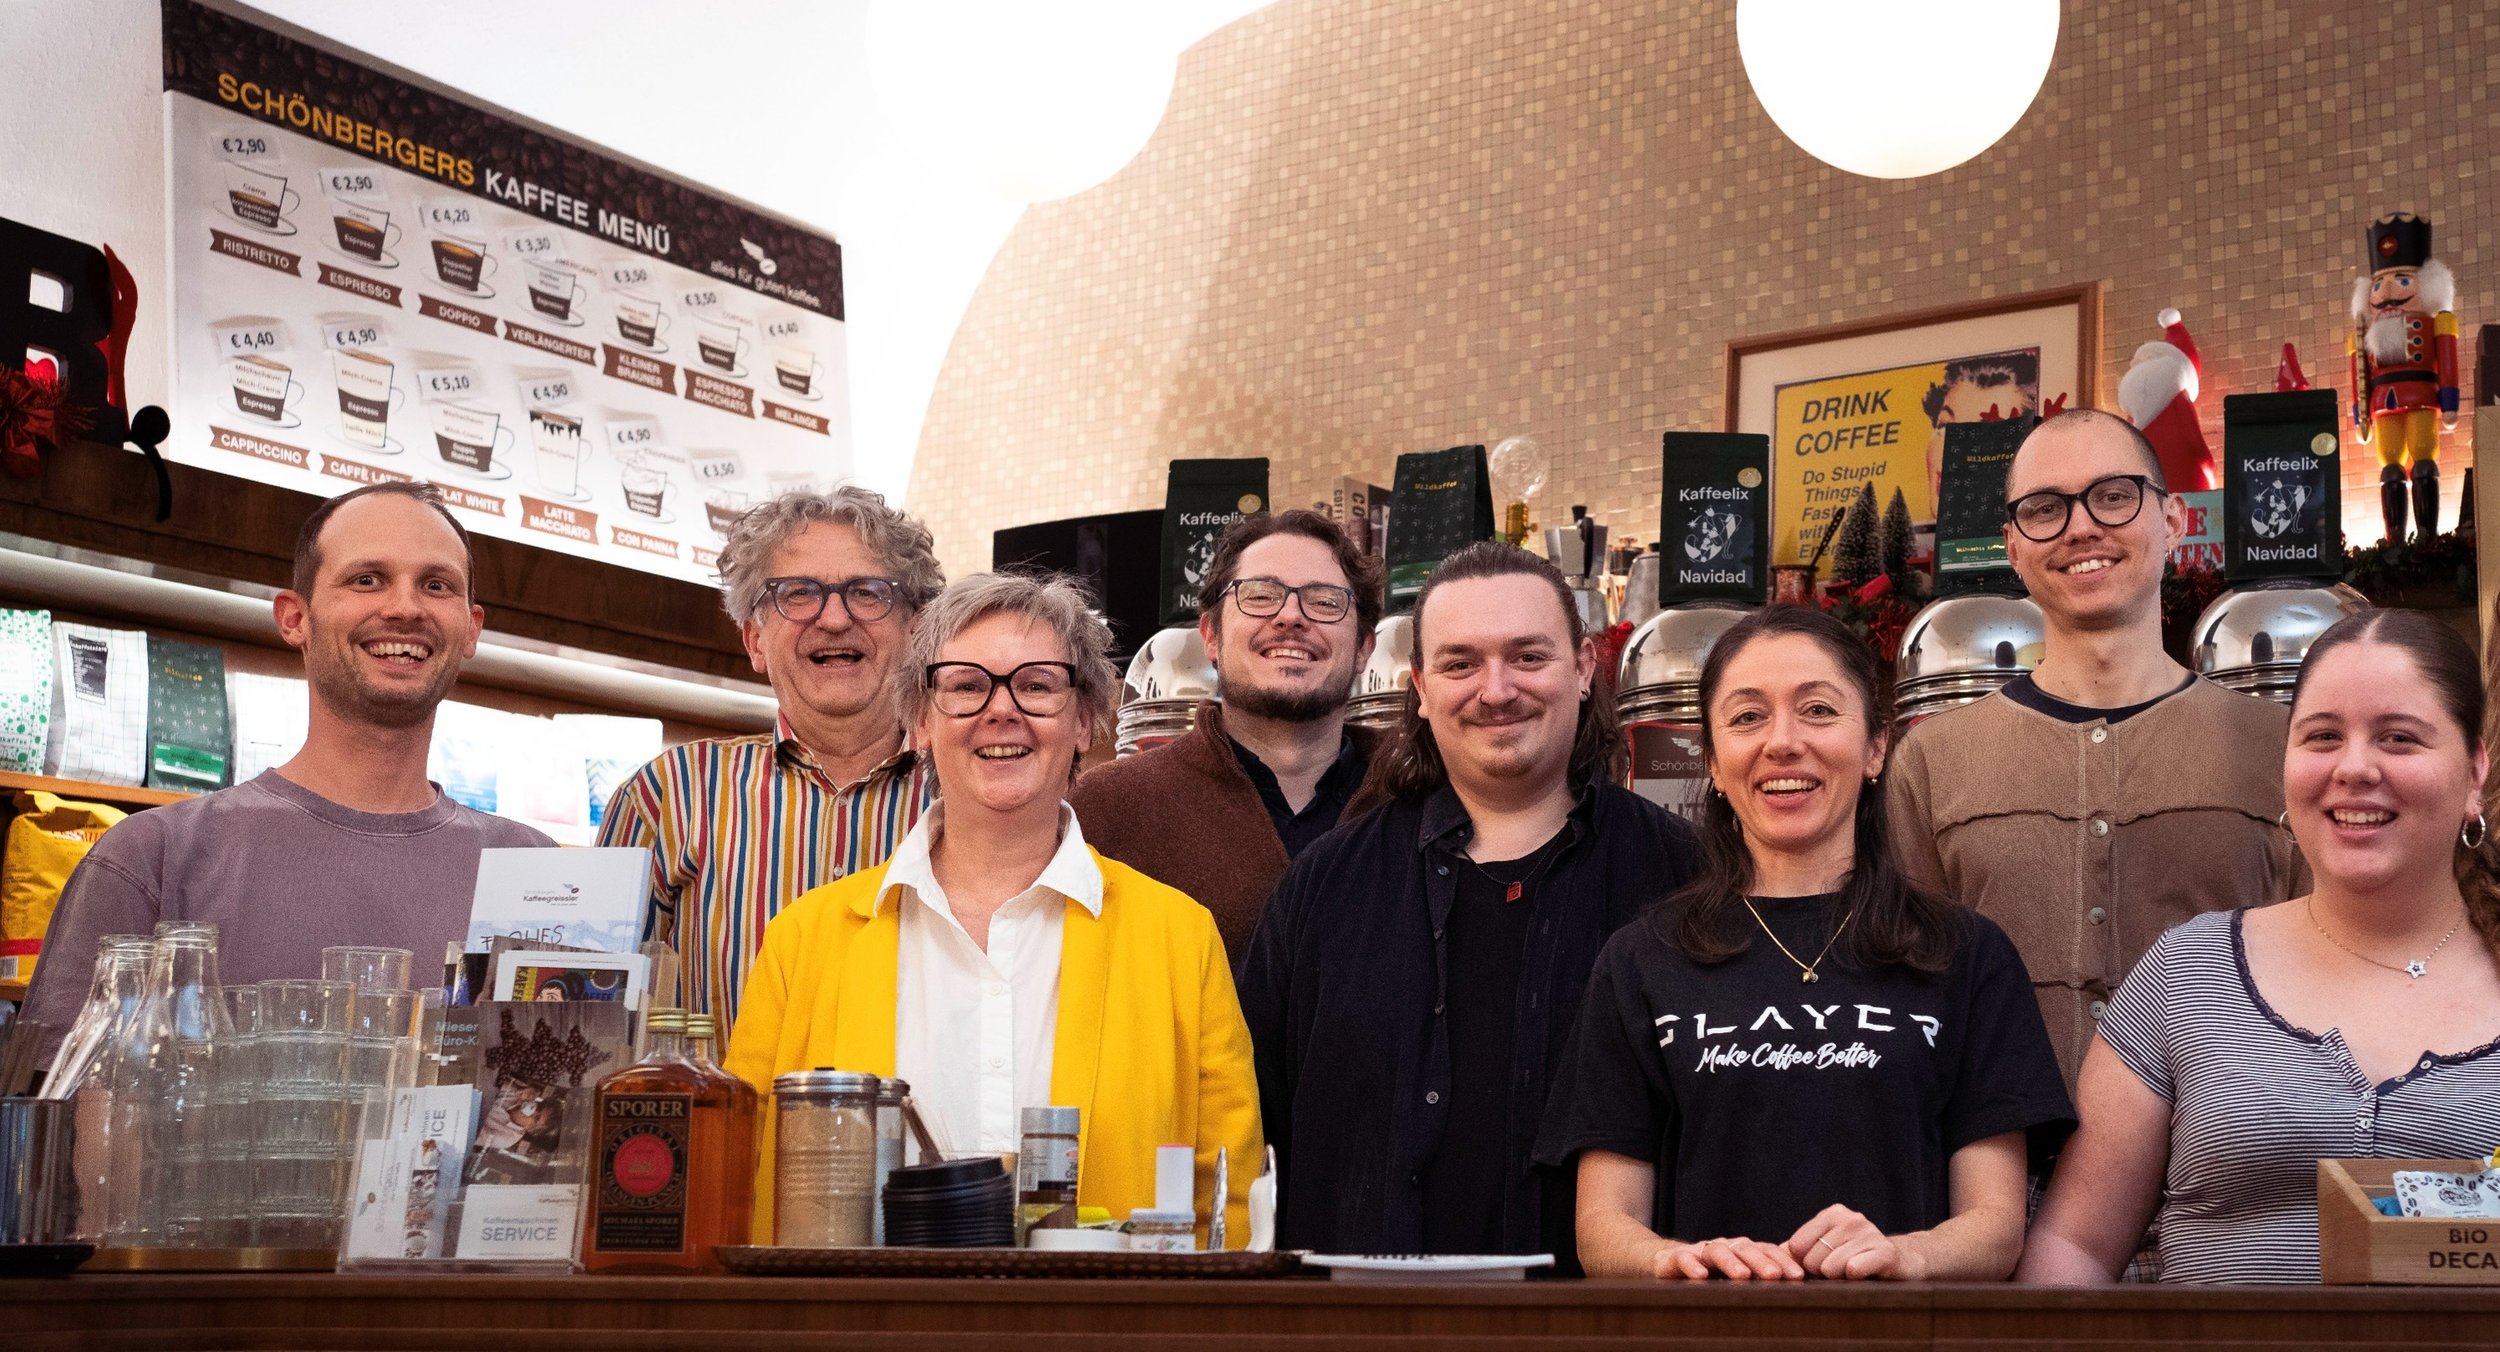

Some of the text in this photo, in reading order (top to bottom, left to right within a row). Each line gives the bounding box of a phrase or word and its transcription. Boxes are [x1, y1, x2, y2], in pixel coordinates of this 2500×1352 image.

[235, 138, 266, 155] 2,90
[217, 72, 670, 254] SCHÖNBERGERS KAFFEE MENÜ
[345, 176, 373, 192] 2,90
[238, 207, 273, 225] Espresso
[444, 209, 470, 224] 4,20
[344, 233, 376, 250] Espresso
[527, 237, 550, 254] 3,30
[223, 239, 290, 269] RISTRETTO
[624, 269, 647, 283] 3,50
[329, 271, 392, 300] ESPRESSO
[695, 292, 717, 306] 3,50
[439, 305, 480, 328] DOPPIO
[244, 331, 274, 351] 4,40
[348, 328, 377, 346] 4,90
[511, 327, 592, 360] VERLÄNGERTER
[619, 353, 661, 374] KLEINER
[443, 376, 470, 392] 5,10
[544, 383, 568, 399] 4,90
[695, 376, 745, 399] ESPRESSO
[242, 396, 276, 413] Espresso
[347, 401, 379, 417] Espresso
[693, 388, 748, 414] MACCHIATO
[1802, 389, 1893, 424] DRINK
[775, 407, 818, 429] MELANGE
[627, 428, 651, 443] 4,90
[1795, 421, 1901, 456] COFFEE
[221, 433, 303, 464] CAPPUCCINO
[330, 461, 369, 479] CAFFÈ
[712, 462, 735, 477] 3,50
[1802, 461, 1887, 485] Do Stupid
[2244, 457, 2319, 472] Kaffeelix
[465, 493, 500, 513] WHITE
[1680, 487, 1749, 501] Kaffeelix
[1805, 485, 1861, 503] Things
[543, 505, 576, 523] LATTE
[1180, 512, 1246, 526] Kaffeelix
[529, 515, 591, 540] MACCHIATO
[617, 531, 676, 556] CON PANNA
[2247, 544, 2317, 561] Navidad
[1680, 569, 1746, 584] Navidad
[523, 895, 579, 904] Kaffeegreissler
[1695, 1042, 1881, 1073] Make Coffee Better
[608, 1100, 684, 1117] SPORER
[610, 1124, 680, 1152] ORIGINAL
[481, 1226, 558, 1241] SERVICE
[2449, 1228, 2488, 1244] BIO
[2429, 1251, 2498, 1269] DECA
